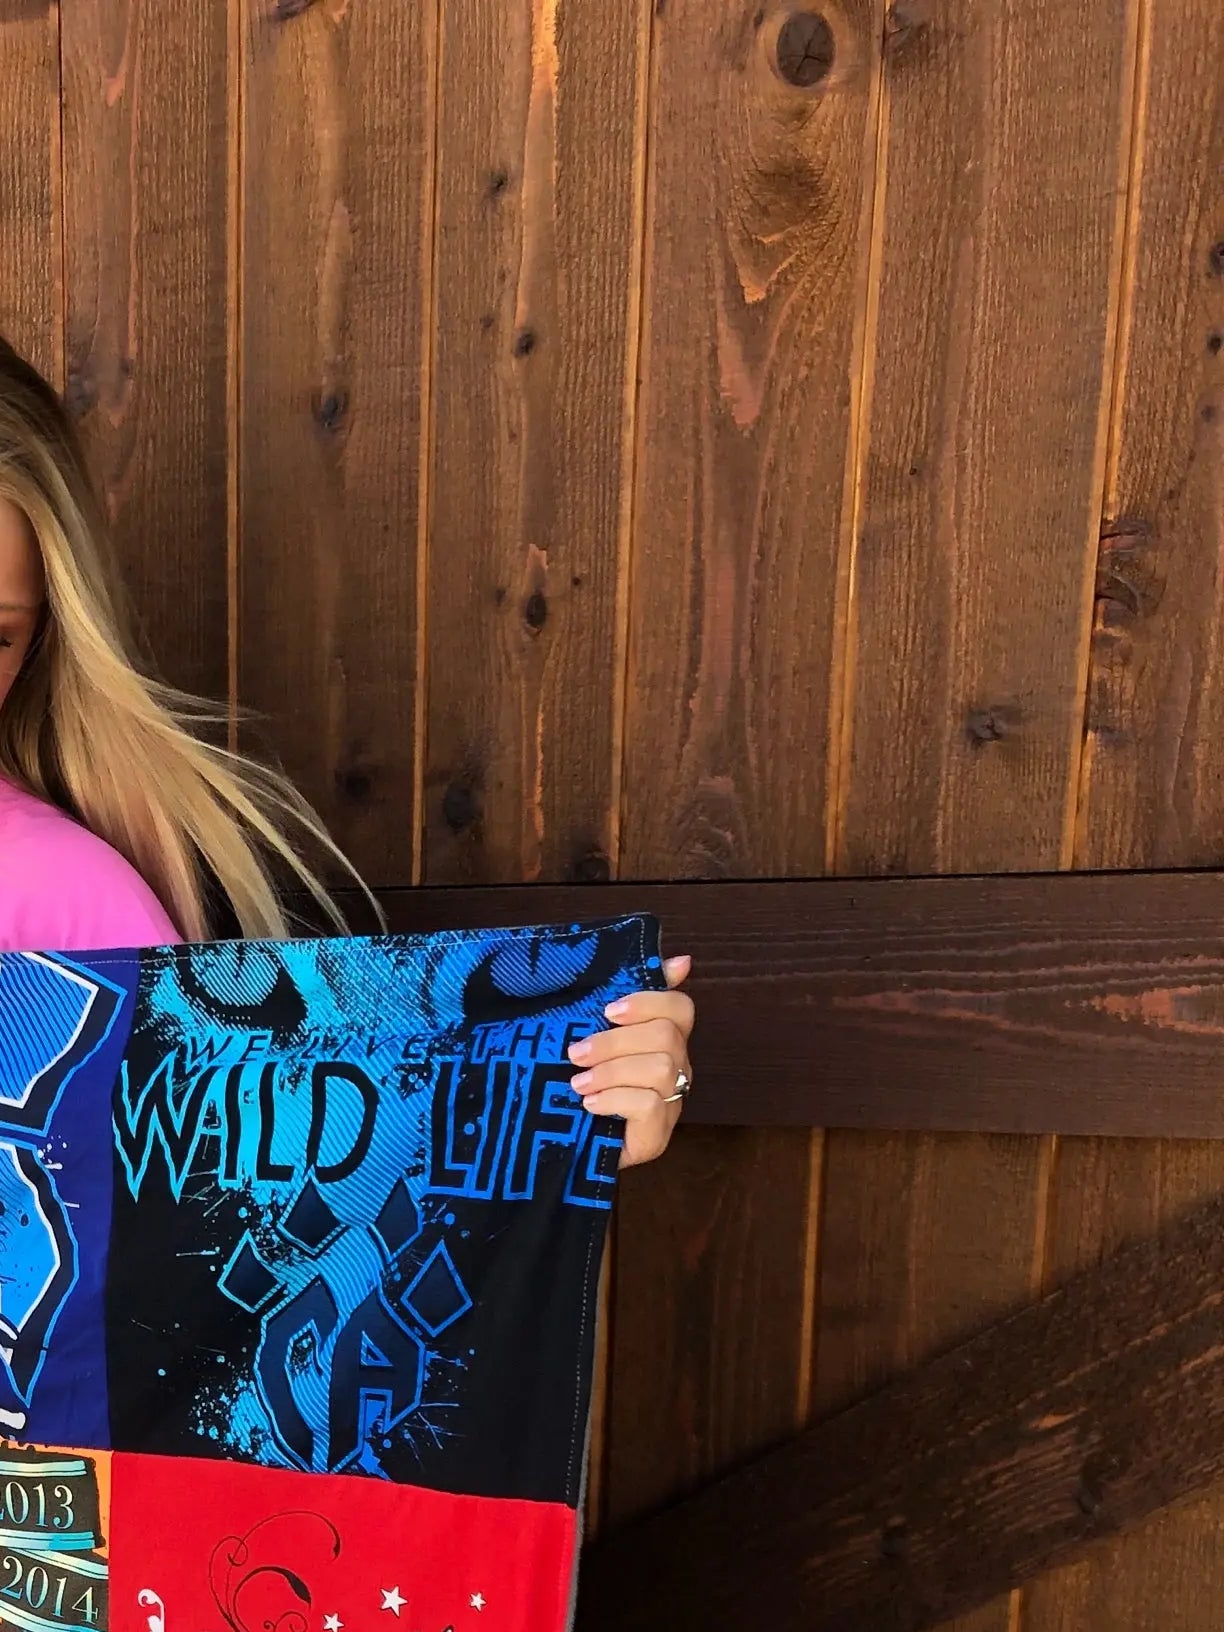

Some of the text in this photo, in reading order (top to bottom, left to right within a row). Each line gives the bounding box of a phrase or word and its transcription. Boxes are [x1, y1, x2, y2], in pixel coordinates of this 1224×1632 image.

[186, 1033, 269, 1069] WE
[472, 1022, 593, 1063] THE
[112, 1060, 378, 1201] WILD
[0, 1555, 98, 1623] 2014
